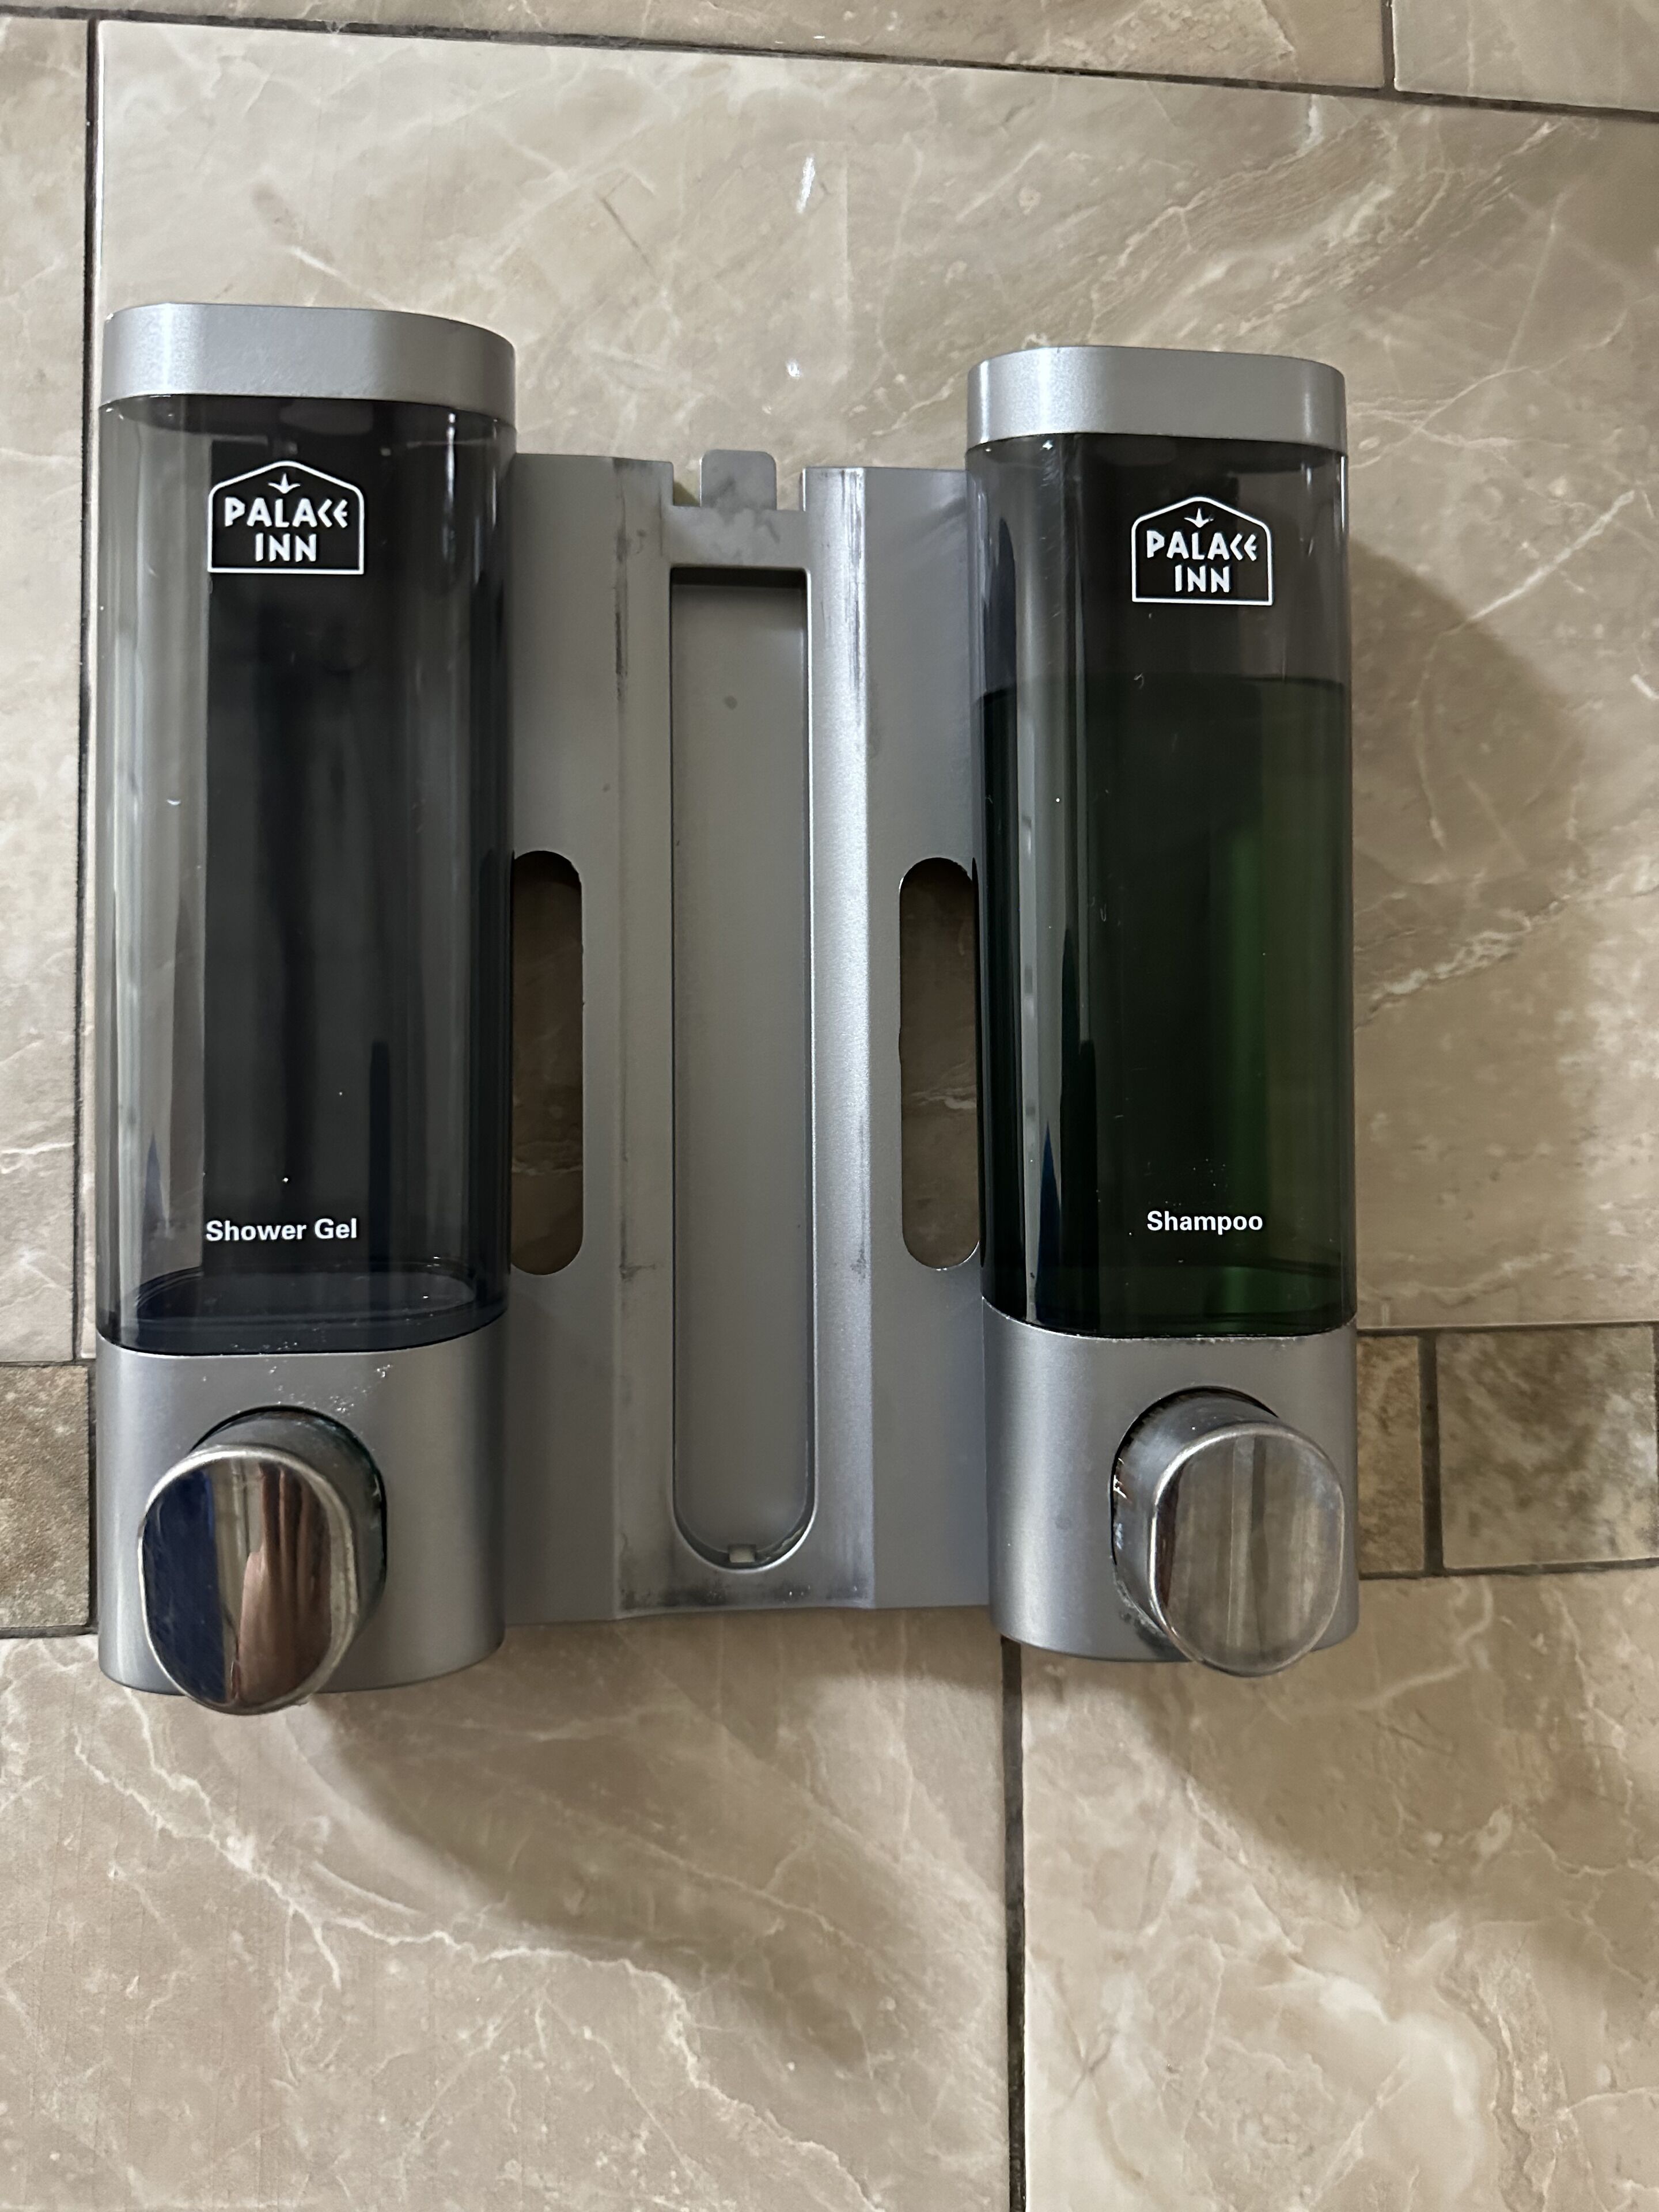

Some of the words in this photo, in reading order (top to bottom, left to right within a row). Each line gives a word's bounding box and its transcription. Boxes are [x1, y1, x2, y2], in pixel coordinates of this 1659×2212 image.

[225, 497, 348, 528] PALACE
[255, 532, 316, 562] INN
[1146, 530, 1257, 561] PALACE
[1175, 565, 1230, 593] INN
[206, 1219, 307, 1241] Shower
[314, 1217, 357, 1239] Gel
[1147, 1210, 1263, 1236] Shampoo
